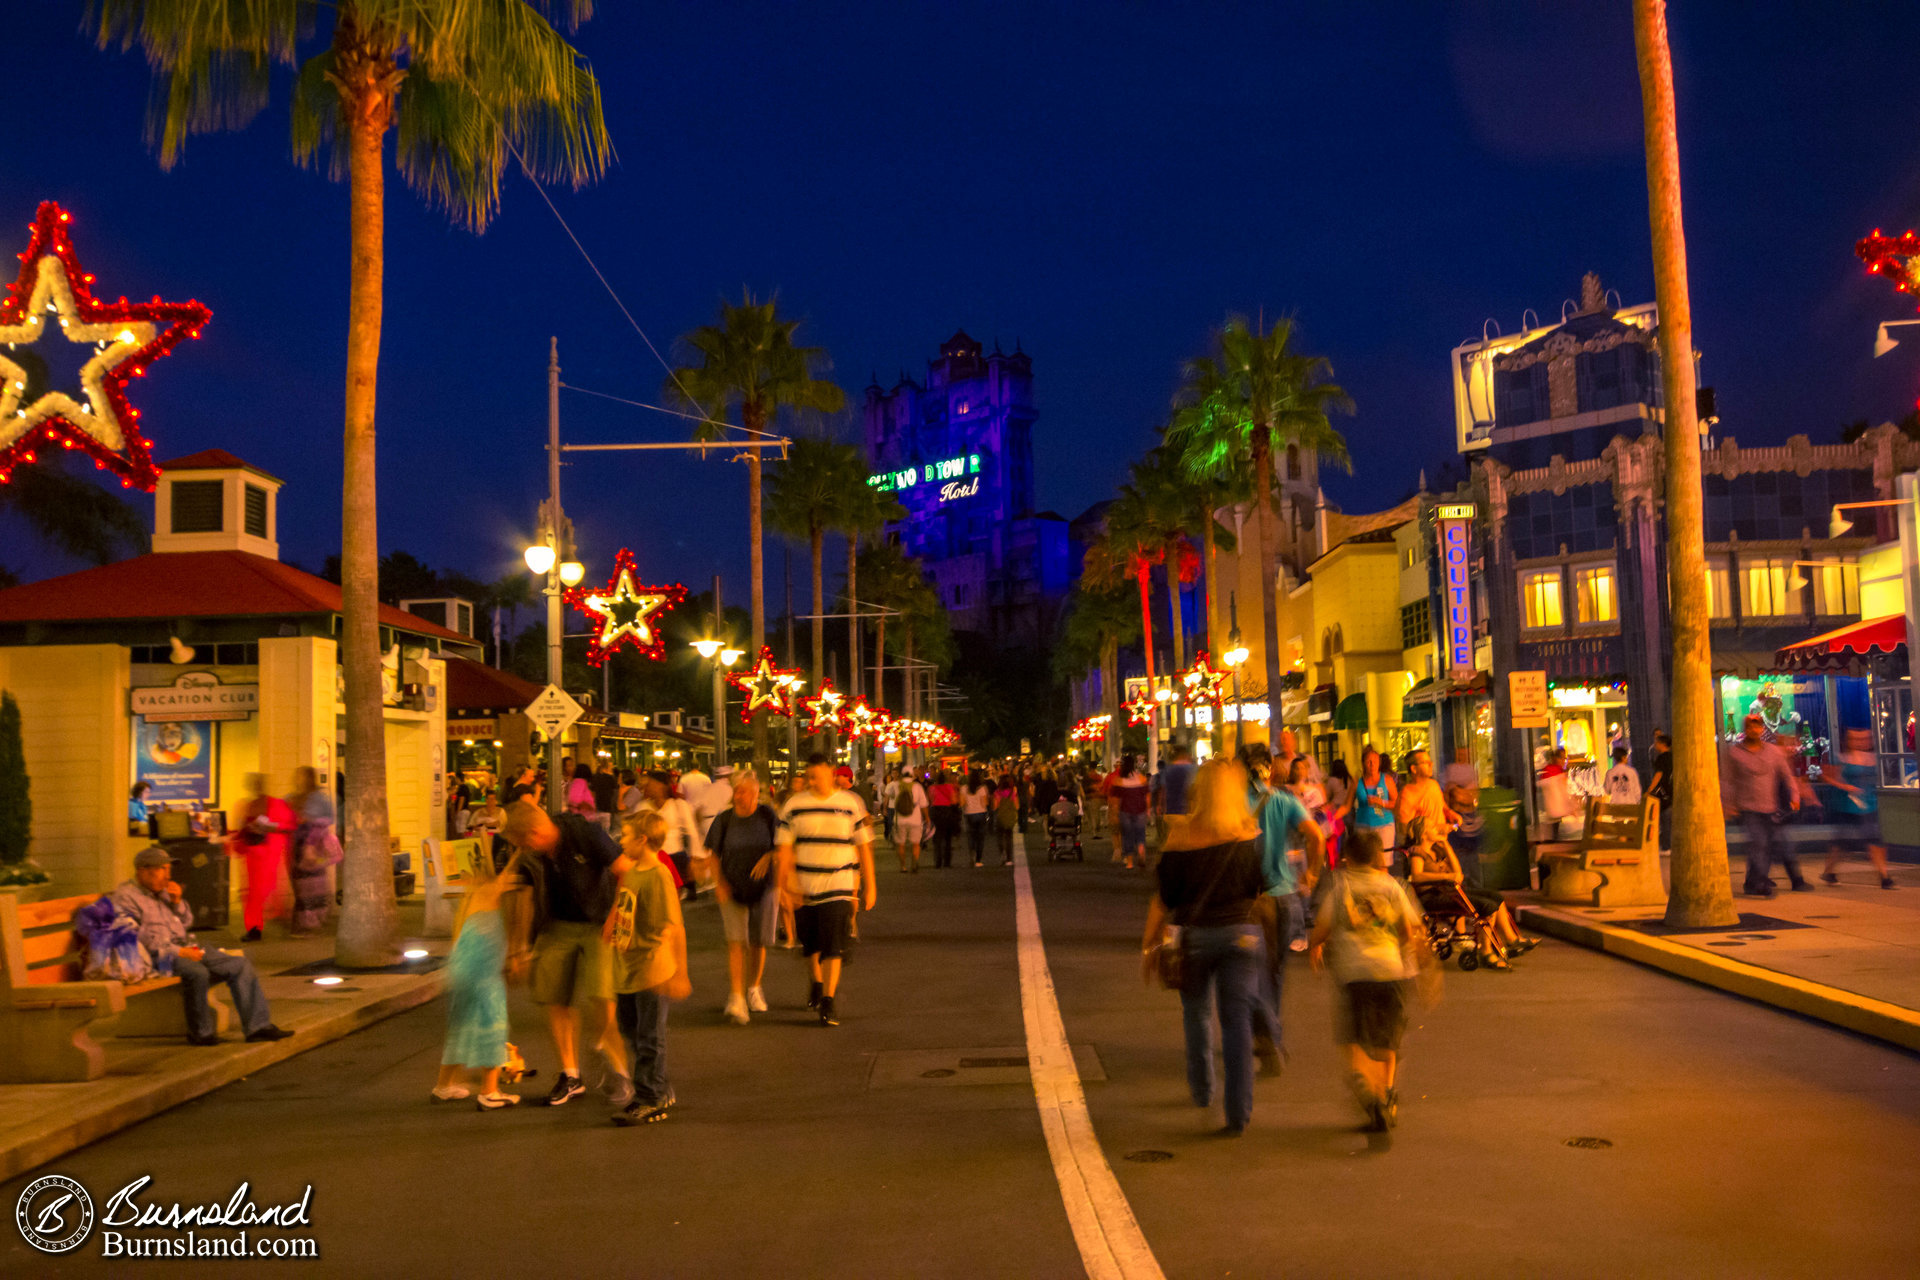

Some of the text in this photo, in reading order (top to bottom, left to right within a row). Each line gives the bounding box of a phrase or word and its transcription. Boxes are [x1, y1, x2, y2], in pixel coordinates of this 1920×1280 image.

[936, 455, 980, 480] TOWR
[939, 476, 979, 502] Hotel
[1448, 527, 1469, 664] COUTURE
[180, 677, 216, 691] Disney
[139, 693, 255, 706] VACATION CLUB
